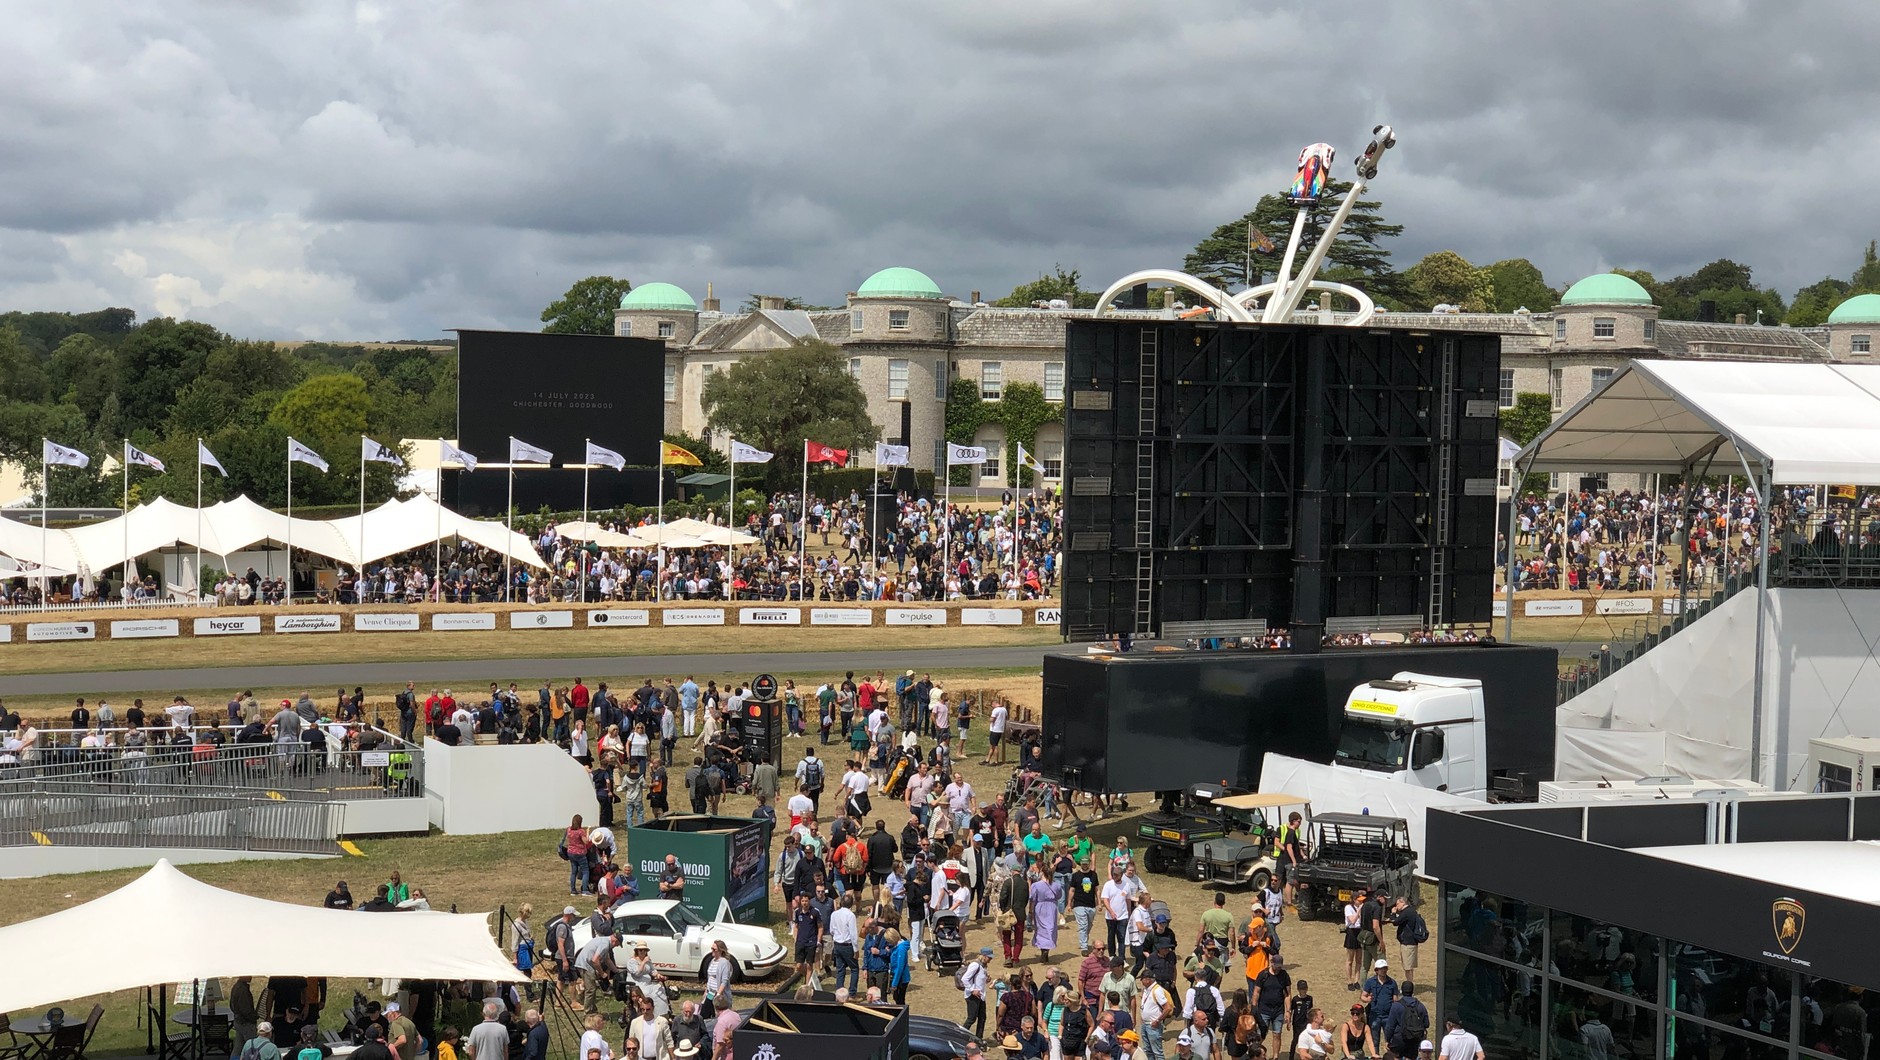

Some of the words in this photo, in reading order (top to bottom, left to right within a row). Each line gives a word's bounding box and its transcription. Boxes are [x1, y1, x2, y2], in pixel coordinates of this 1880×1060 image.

[548, 392, 569, 400] JULY
[363, 617, 382, 625] Veuve
[383, 616, 412, 627] Clicquot
[752, 612, 788, 621] PIRELLI
[910, 612, 933, 622] pulse
[209, 620, 245, 631] heycar
[280, 618, 337, 630] Lamborghini
[641, 860, 666, 873] GOOD
[682, 862, 711, 877] WOOD
